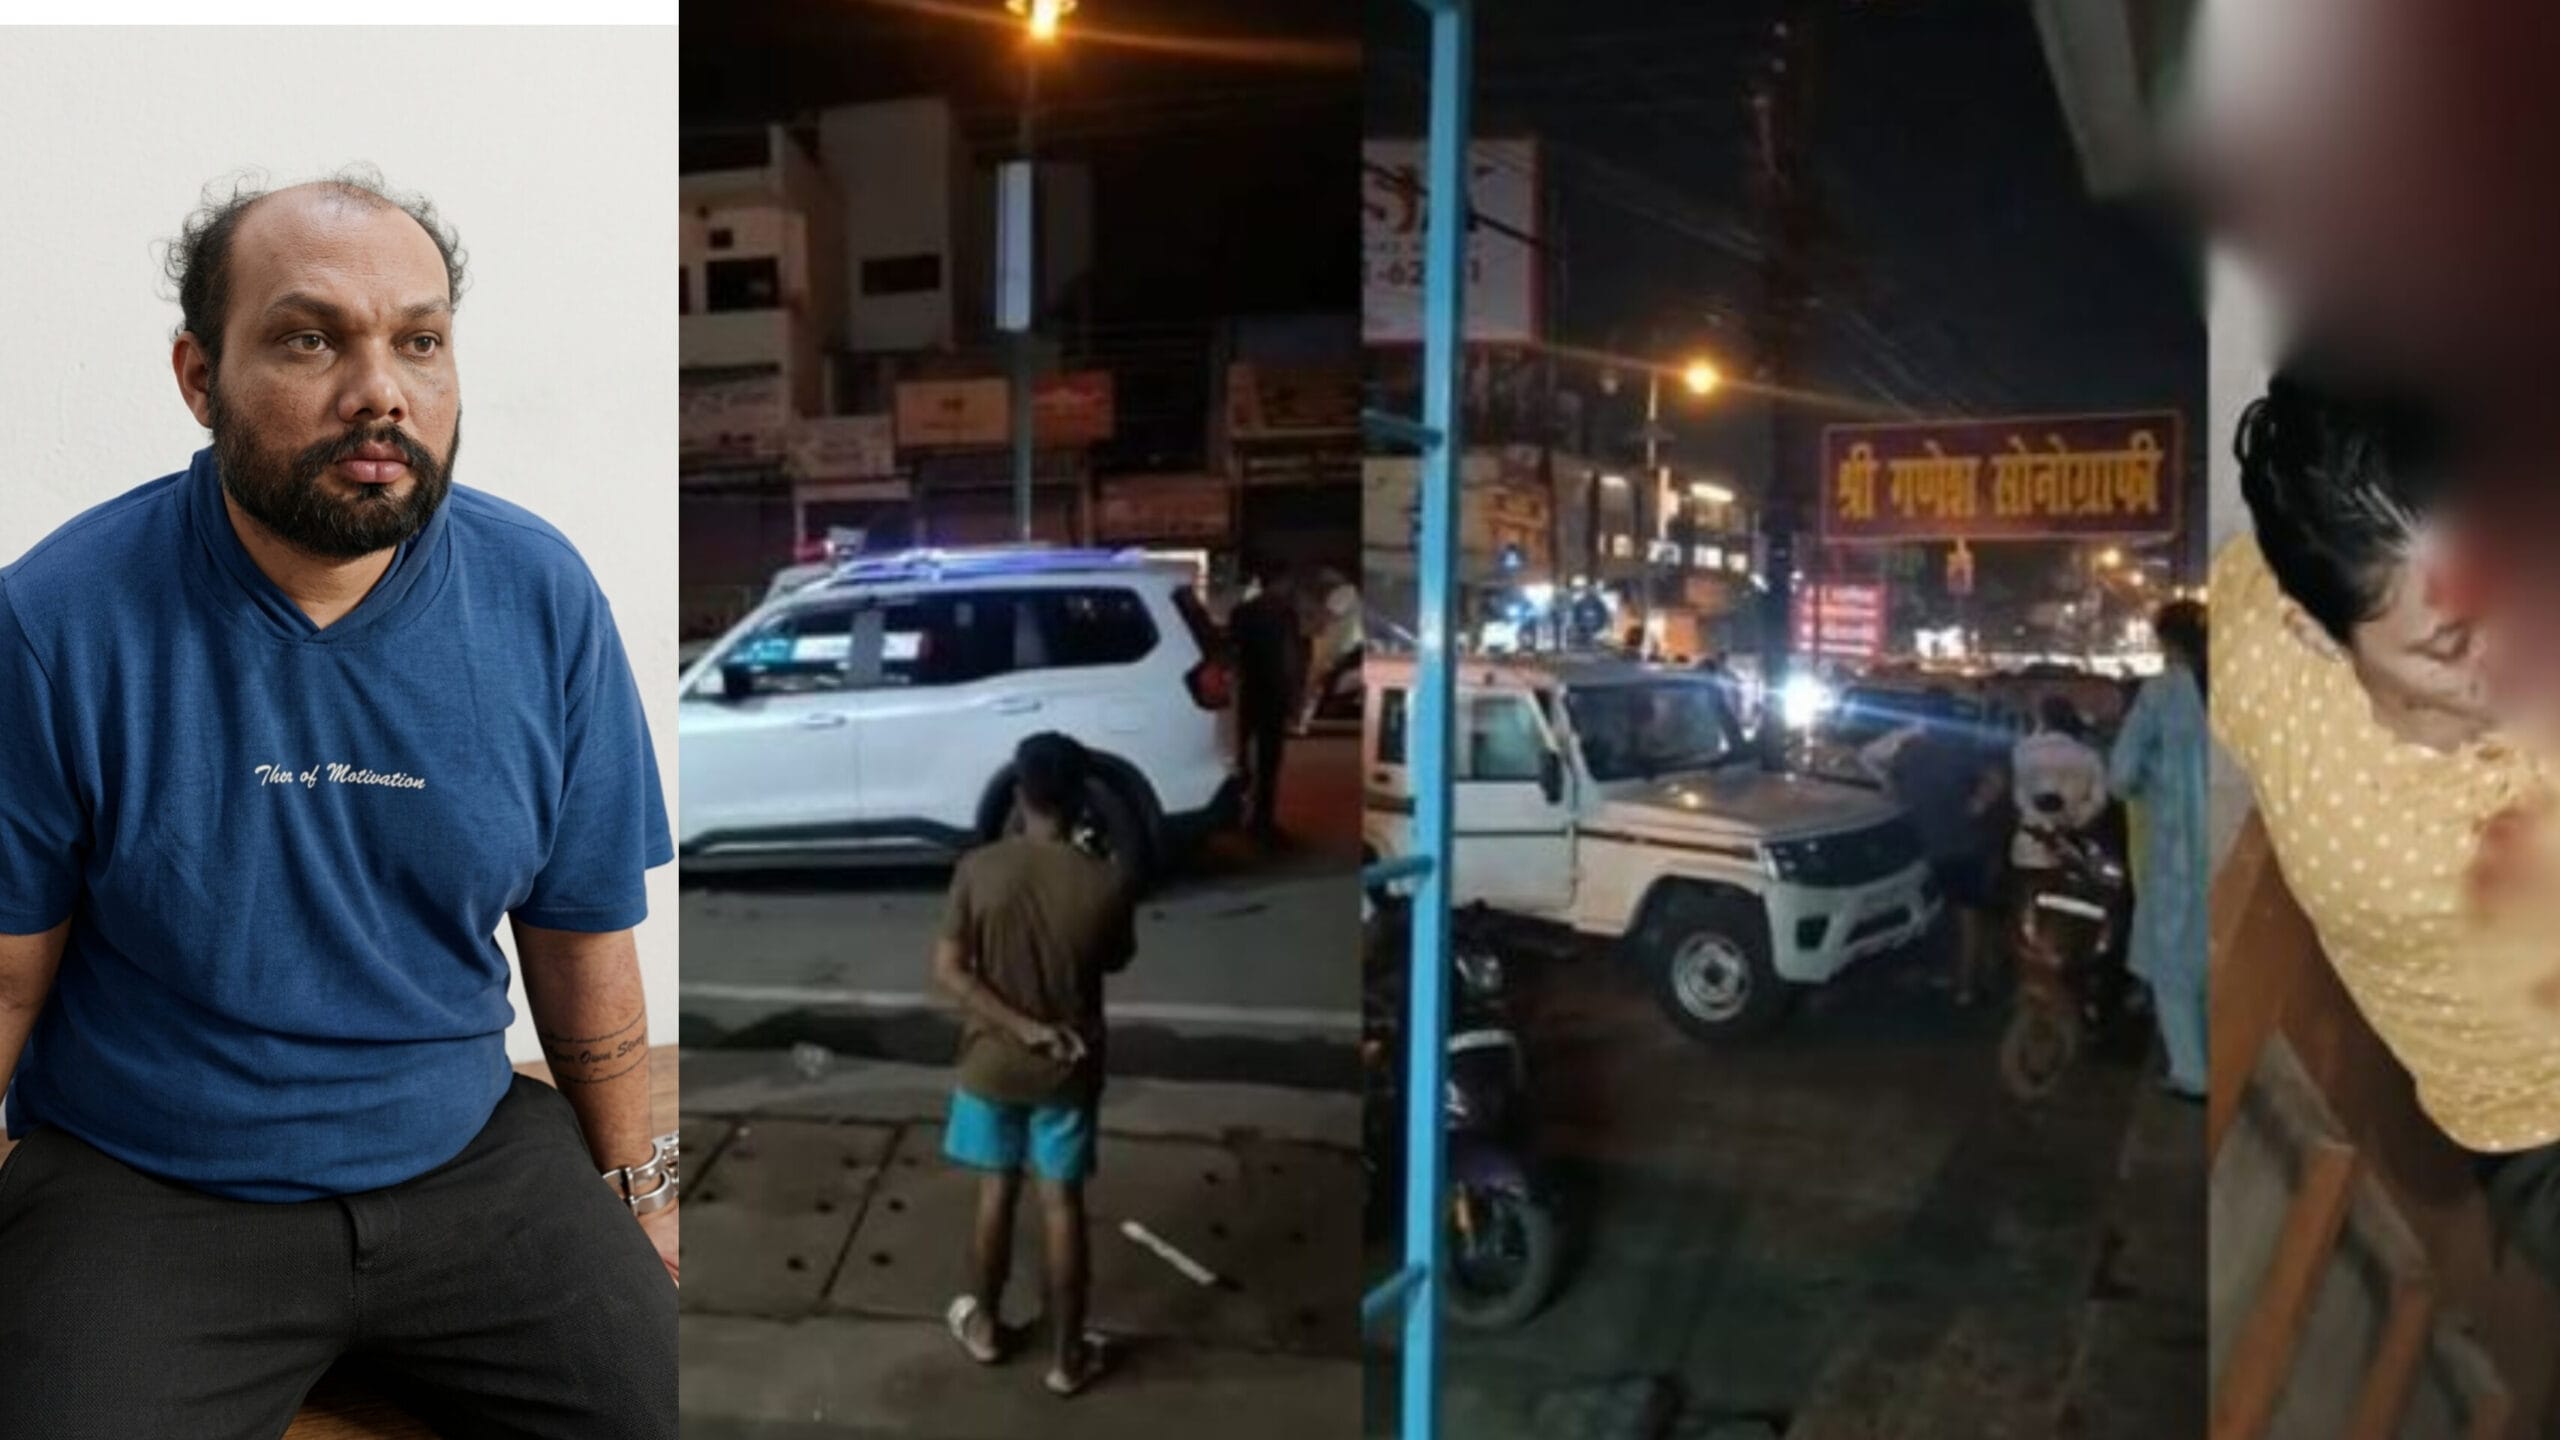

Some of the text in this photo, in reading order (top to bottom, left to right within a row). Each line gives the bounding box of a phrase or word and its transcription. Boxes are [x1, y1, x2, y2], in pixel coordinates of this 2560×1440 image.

[1838, 443, 1877, 520] श्री
[1889, 439, 1982, 519] गणेश
[299, 764, 320, 788] of
[326, 763, 426, 789] Motivation
